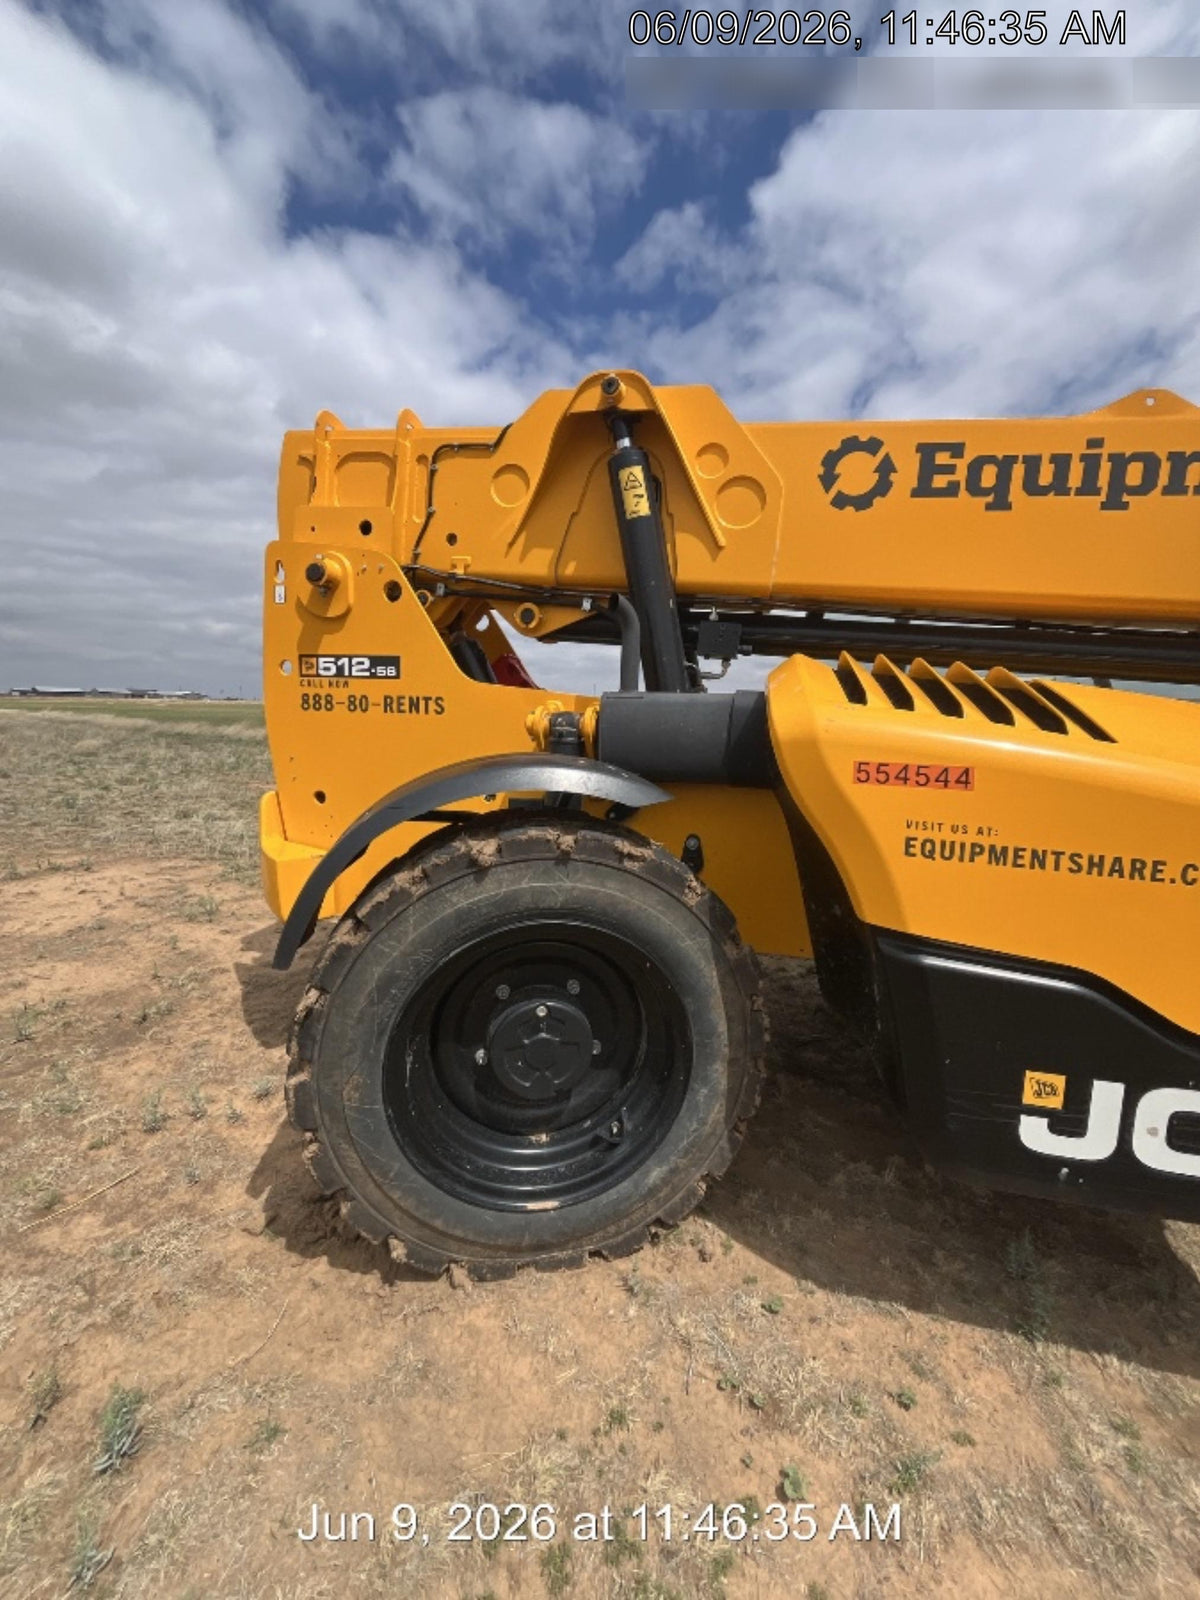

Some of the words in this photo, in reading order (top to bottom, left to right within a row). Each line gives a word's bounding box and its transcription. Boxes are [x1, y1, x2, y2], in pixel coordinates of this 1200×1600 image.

[300, 693, 446, 715] 888-80-RENTS
[856, 762, 972, 789] 554544
[905, 819, 944, 833] VISIT
[950, 824, 968, 834] US
[975, 826, 999, 837] AT:
[904, 837, 1200, 886] EQUIPMENTSHARE.C
